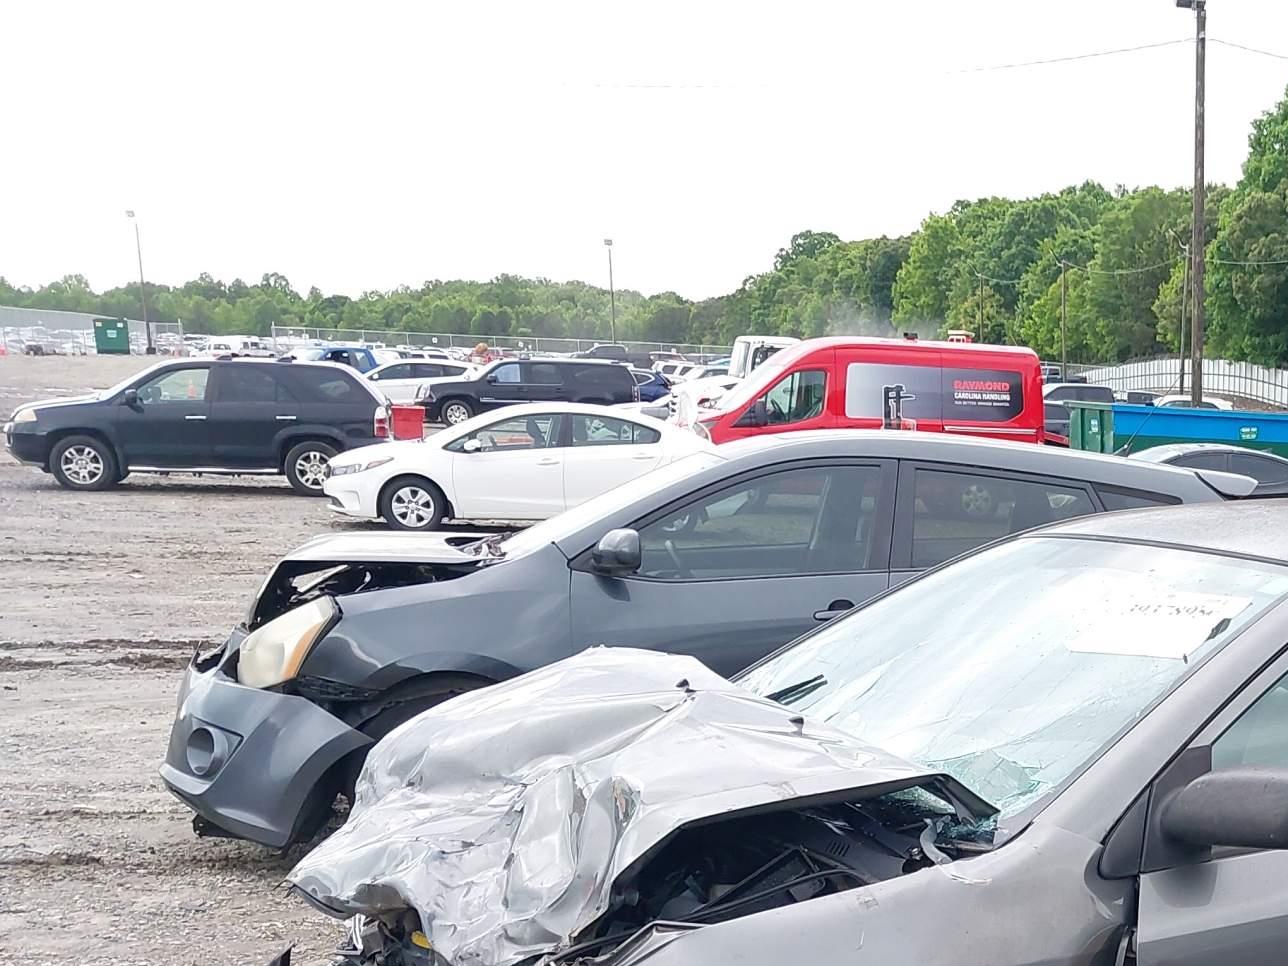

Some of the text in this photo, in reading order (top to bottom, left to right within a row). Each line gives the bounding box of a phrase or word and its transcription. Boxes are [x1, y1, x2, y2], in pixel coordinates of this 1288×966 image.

[953, 379, 1010, 392] RAYMOND
[954, 392, 1010, 401] CAROLINA HANDLING
